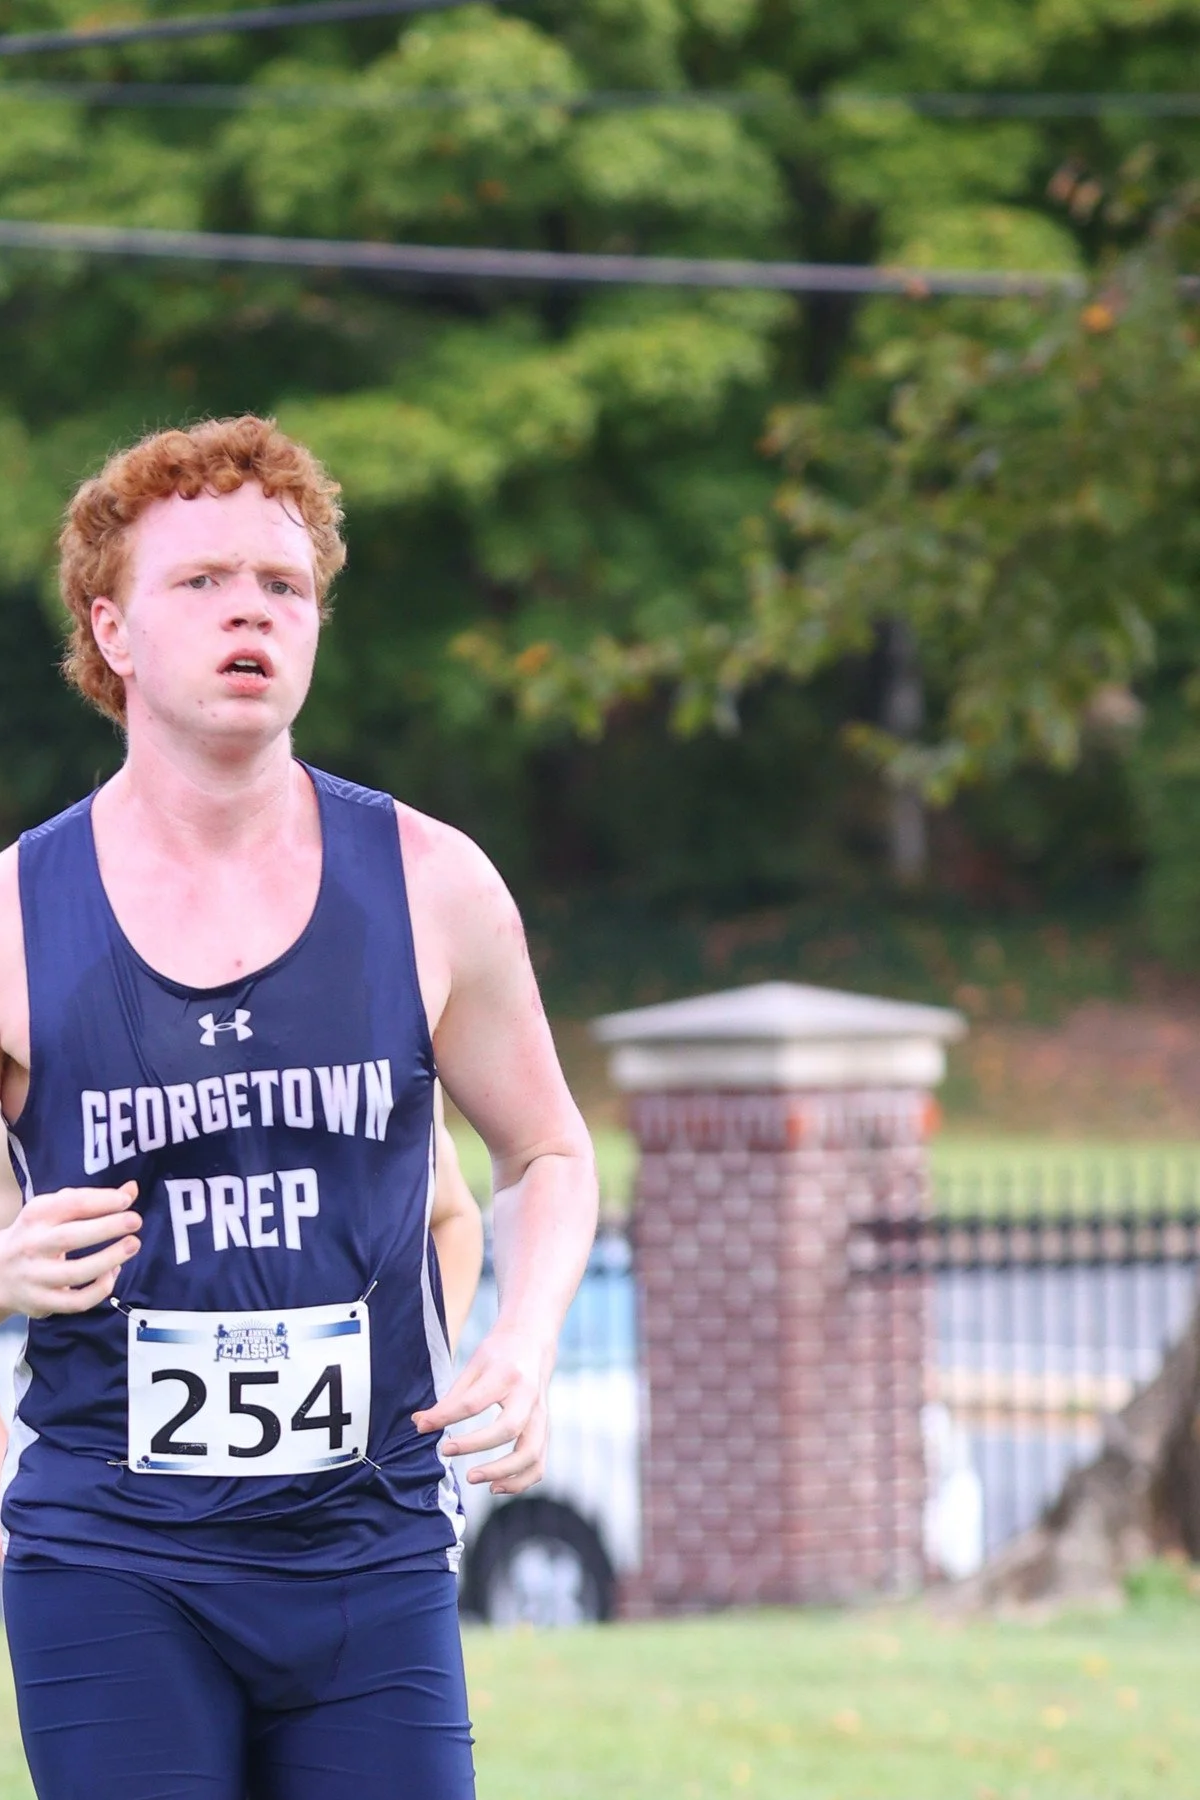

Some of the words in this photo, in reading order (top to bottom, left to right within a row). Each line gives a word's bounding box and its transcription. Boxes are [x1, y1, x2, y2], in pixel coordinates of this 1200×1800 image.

[81, 1058, 395, 1176] GEORGETOWN
[164, 1167, 320, 1266] PREP
[221, 1343, 284, 1360] CLASSIC
[149, 1363, 352, 1458] 254
